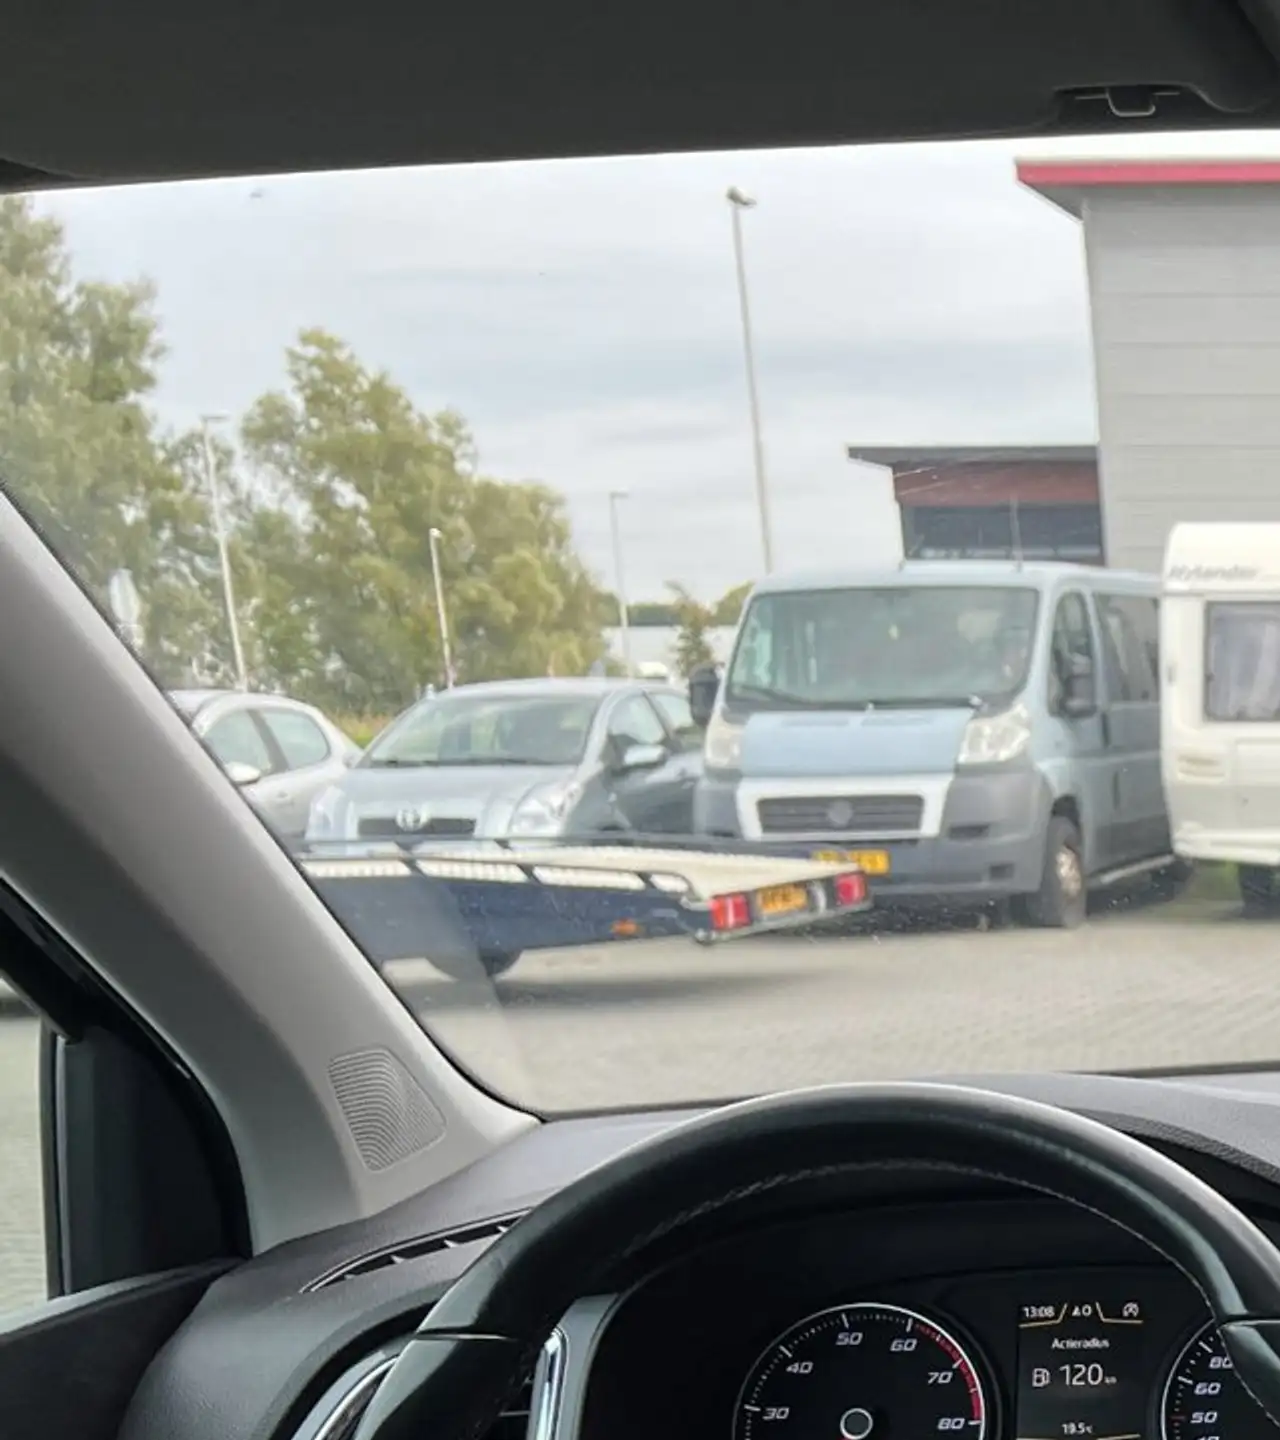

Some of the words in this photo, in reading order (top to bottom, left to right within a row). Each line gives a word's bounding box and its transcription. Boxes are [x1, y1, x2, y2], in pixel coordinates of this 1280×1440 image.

[836, 1332, 863, 1346] 50
[890, 1338, 917, 1352] 60
[786, 1361, 813, 1375] 40
[1208, 1356, 1233, 1370] 80
[927, 1371, 952, 1384] 70
[1059, 1363, 1103, 1386] 120
[1194, 1382, 1221, 1396] 60
[763, 1406, 790, 1420] 30
[1190, 1411, 1217, 1424] 50
[937, 1417, 965, 1431] 80
